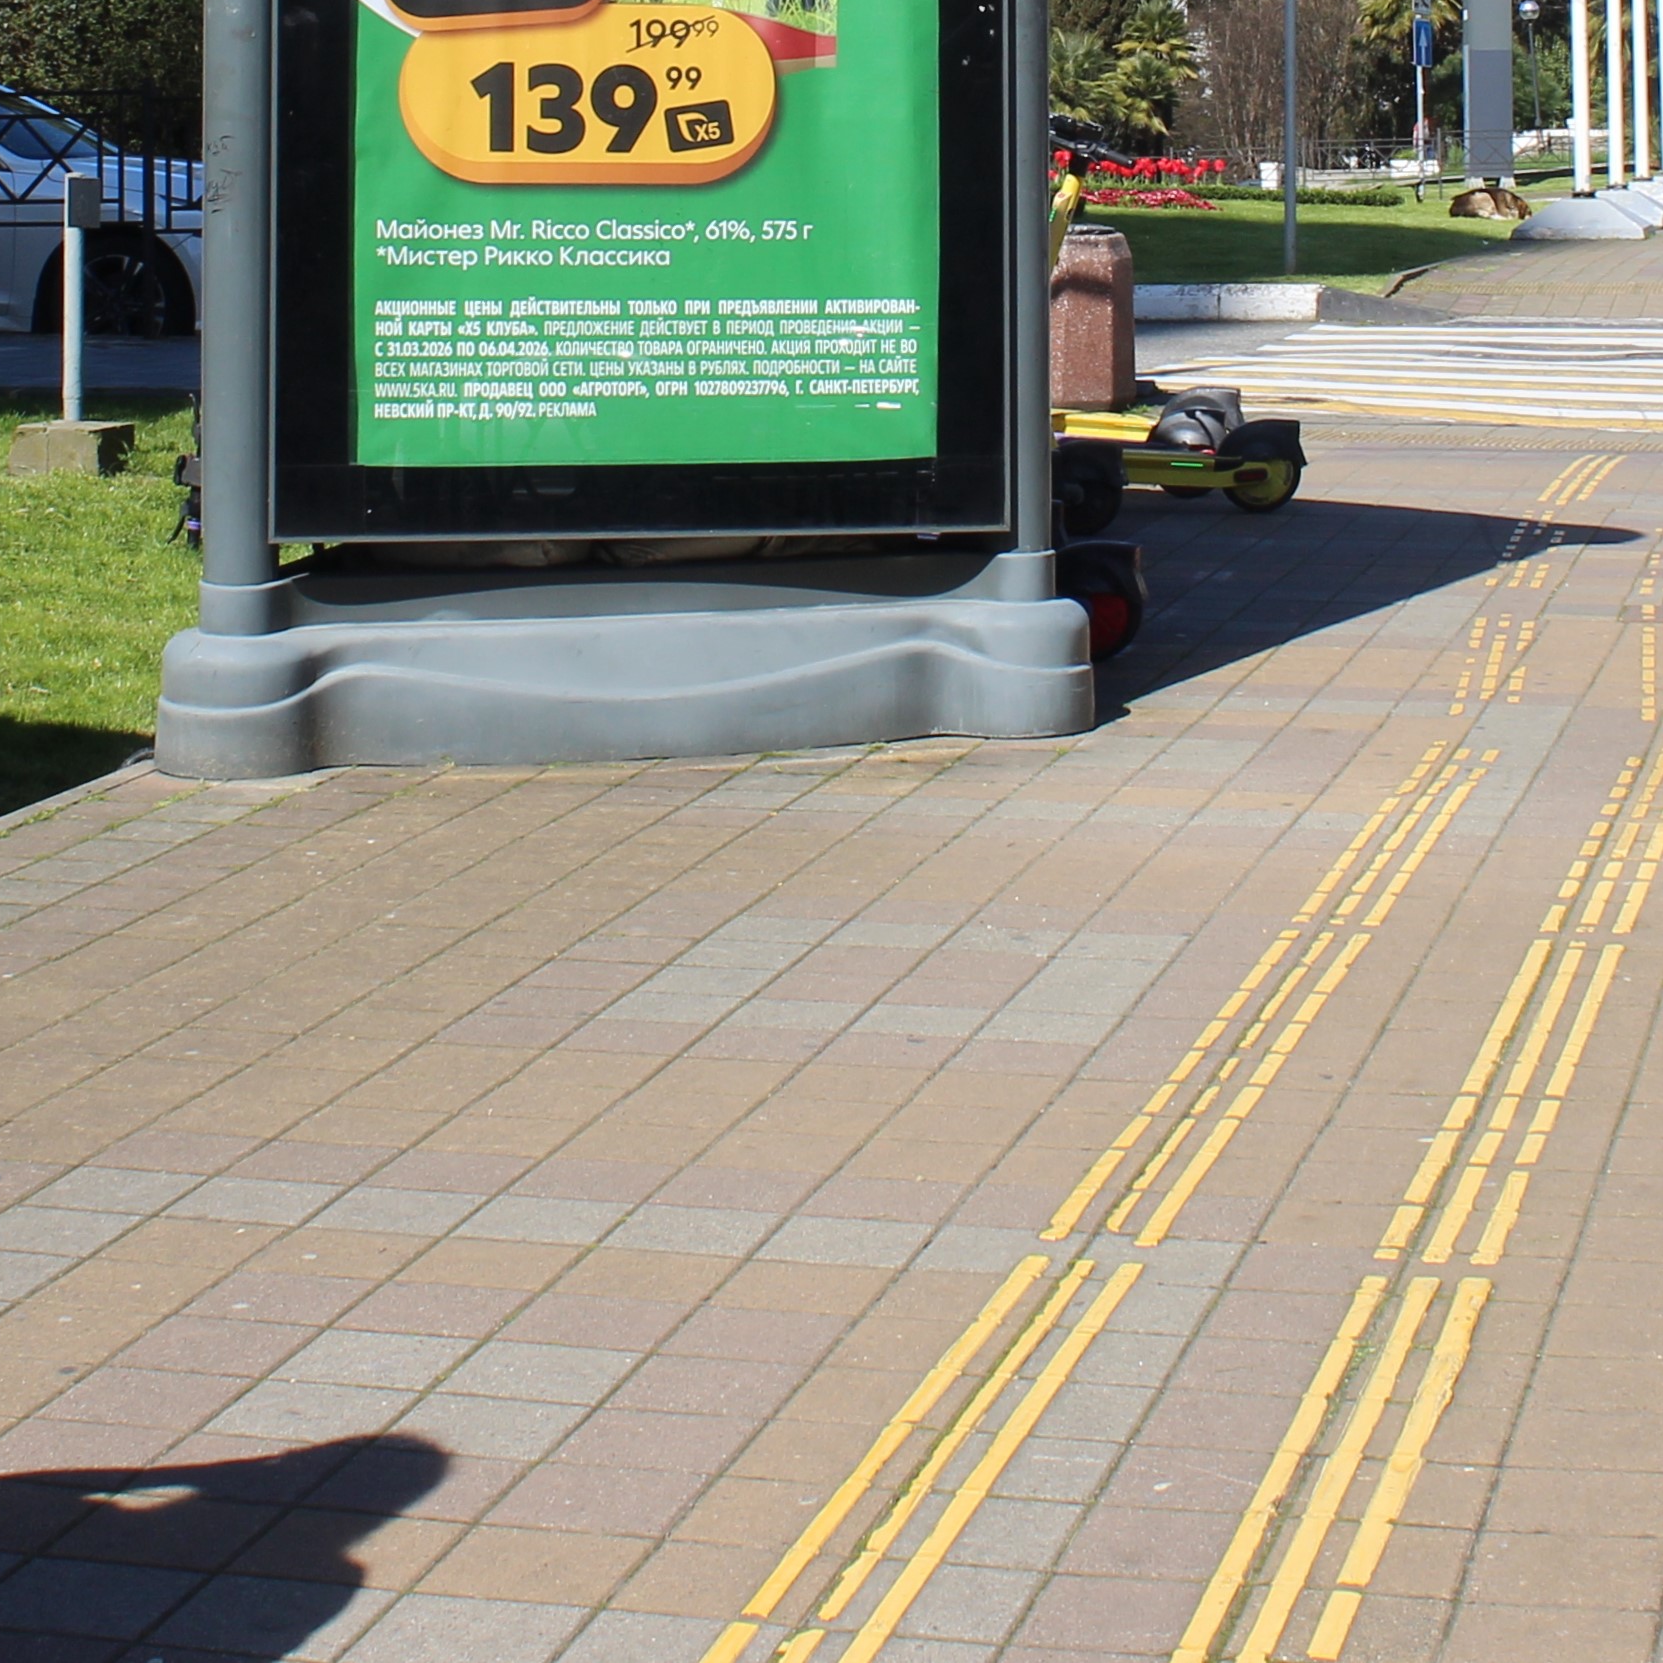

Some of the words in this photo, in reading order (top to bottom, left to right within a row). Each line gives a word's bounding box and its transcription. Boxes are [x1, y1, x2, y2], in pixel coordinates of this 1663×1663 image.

[470, 61, 658, 155] 139
[665, 66, 703, 91] 99
[376, 218, 484, 240] Майонез
[490, 220, 525, 240] Mr.
[532, 220, 590, 240] Ricco
[705, 220, 756, 243] 61%,
[762, 220, 798, 240] 575
[803, 225, 813, 240] г
[485, 247, 553, 266] Рикко
[559, 247, 671, 267] Классика
[374, 300, 457, 318] АКЦИОННЫЕ
[464, 300, 503, 318] ЦЕНЫ
[509, 297, 621, 318] ДЕЙСТВИТЕЛЬНЫ
[627, 300, 678, 316] ТОЛЬКО
[684, 300, 711, 315] ПРИ
[718, 299, 819, 317] ПРЕДЪЯВЛЕНИИ
[824, 299, 921, 315] АКТИВИРОВАН-
[375, 317, 404, 336] НОЙ
[408, 321, 452, 336] КАРТЫ
[486, 321, 539, 336] КЛУБА».
[543, 320, 635, 338] ПРЕДЛОЖЕНИЕ
[639, 317, 708, 337] ДЕЙСТВУЕТ
[712, 320, 721, 335] В
[726, 320, 775, 336] ПЕРИОД
[779, 320, 857, 336] ПРОВЕДЕНИЯ
[861, 320, 904, 336] АКЦИИ
[374, 341, 384, 357] С
[387, 341, 453, 357] 31.03.2026
[457, 341, 475, 357] ПО
[478, 341, 552, 357] 06.04.2026.
[556, 340, 635, 356] КОЛИЧЕСТВО
[637, 340, 684, 356] ТОВАРА
[686, 340, 768, 355] ОГРАНИЧЕНО.
[770, 339, 811, 356] АКЦИЯ
[815, 339, 877, 355] ПРОХОДИТ
[880, 339, 896, 354] НЕ
[900, 339, 917, 354] ВО
[374, 362, 406, 377] ВСЕХ
[409, 362, 484, 377] МАГАЗИНАХ
[486, 358, 549, 377] ТОРГОВОЙ
[552, 361, 586, 376] СЕТИ.
[589, 361, 624, 378] ЦЕНЫ
[628, 360, 685, 376] УКАЗАНЫ
[688, 360, 697, 376] В
[700, 360, 750, 376] РУБЛЯХ.
[752, 360, 840, 376] ПОДРОБНОСТИ
[859, 359, 876, 374] НА
[878, 356, 917, 373] САЙТЕ
[374, 382, 458, 398] WWW.5KA.RU.
[464, 382, 534, 400] ПРОДАВЕЦ
[539, 381, 567, 397] ООО
[572, 381, 650, 398] «АГРОТОРГ»,
[655, 381, 688, 397] ОГРН
[694, 380, 790, 397] 1027809237796,
[795, 379, 804, 395] Г.
[809, 379, 920, 396] САНКТ-ПЕТЕРБУРГ,
[374, 399, 434, 419] НЕВСКИЙ
[437, 403, 477, 420] ПР-КТ,
[478, 403, 493, 420] Д.
[495, 401, 536, 420] 90/92.
[538, 401, 597, 418] РЕКЛАМА
